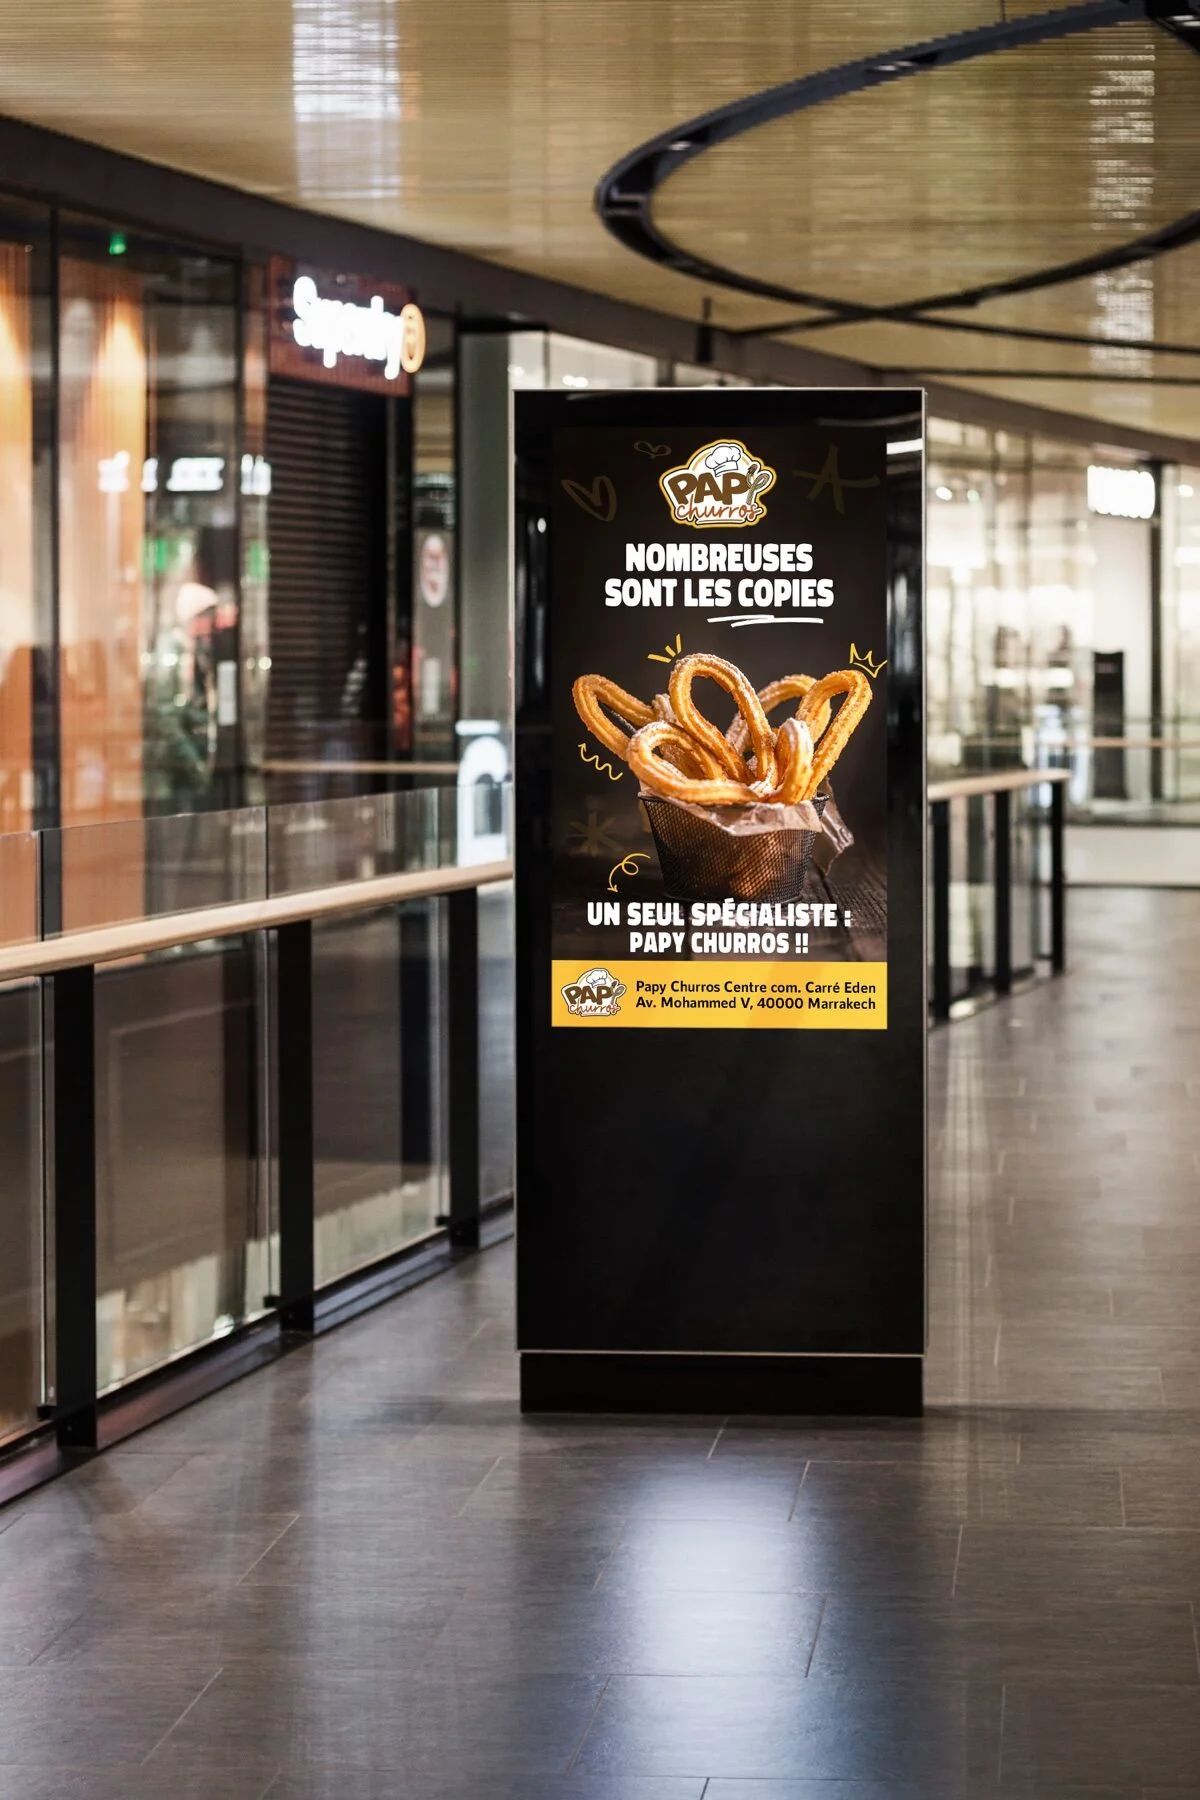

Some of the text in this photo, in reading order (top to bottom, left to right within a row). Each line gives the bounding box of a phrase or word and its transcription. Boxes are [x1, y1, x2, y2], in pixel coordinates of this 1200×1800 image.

[677, 494, 762, 520] churros
[625, 543, 814, 572] NOMBREUSES
[604, 578, 835, 608] SONT LES COPIES
[587, 901, 620, 926] UN
[627, 901, 685, 927] SEUL
[691, 897, 838, 927] SPÉCIALISTE
[629, 931, 809, 954] PAPY CHURROS !!
[636, 980, 876, 995] Papy Churros Centre com. Carré Eden
[635, 996, 876, 1011] Av. Mohammed V, 40000 Marrakech
